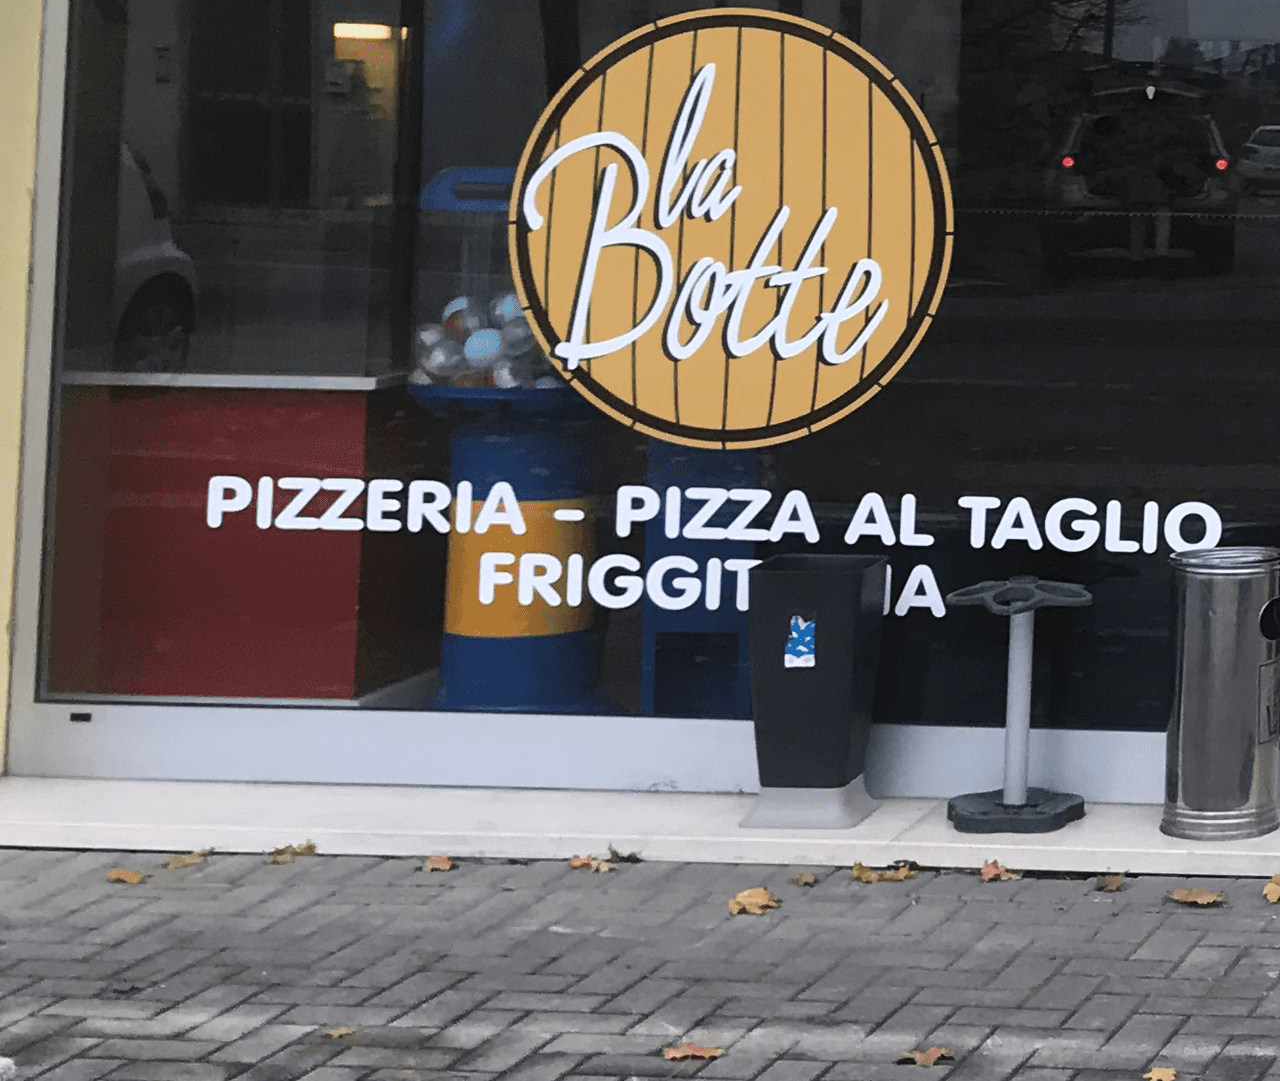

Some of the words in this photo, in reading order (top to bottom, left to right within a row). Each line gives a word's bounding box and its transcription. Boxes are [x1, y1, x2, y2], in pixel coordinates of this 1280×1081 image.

[658, 63, 743, 228] la
[523, 130, 890, 370] Botte
[206, 475, 527, 536] PIZZERIA
[615, 485, 820, 544] PIZZA
[844, 492, 935, 547] AL
[957, 496, 1223, 554] TAGLIO
